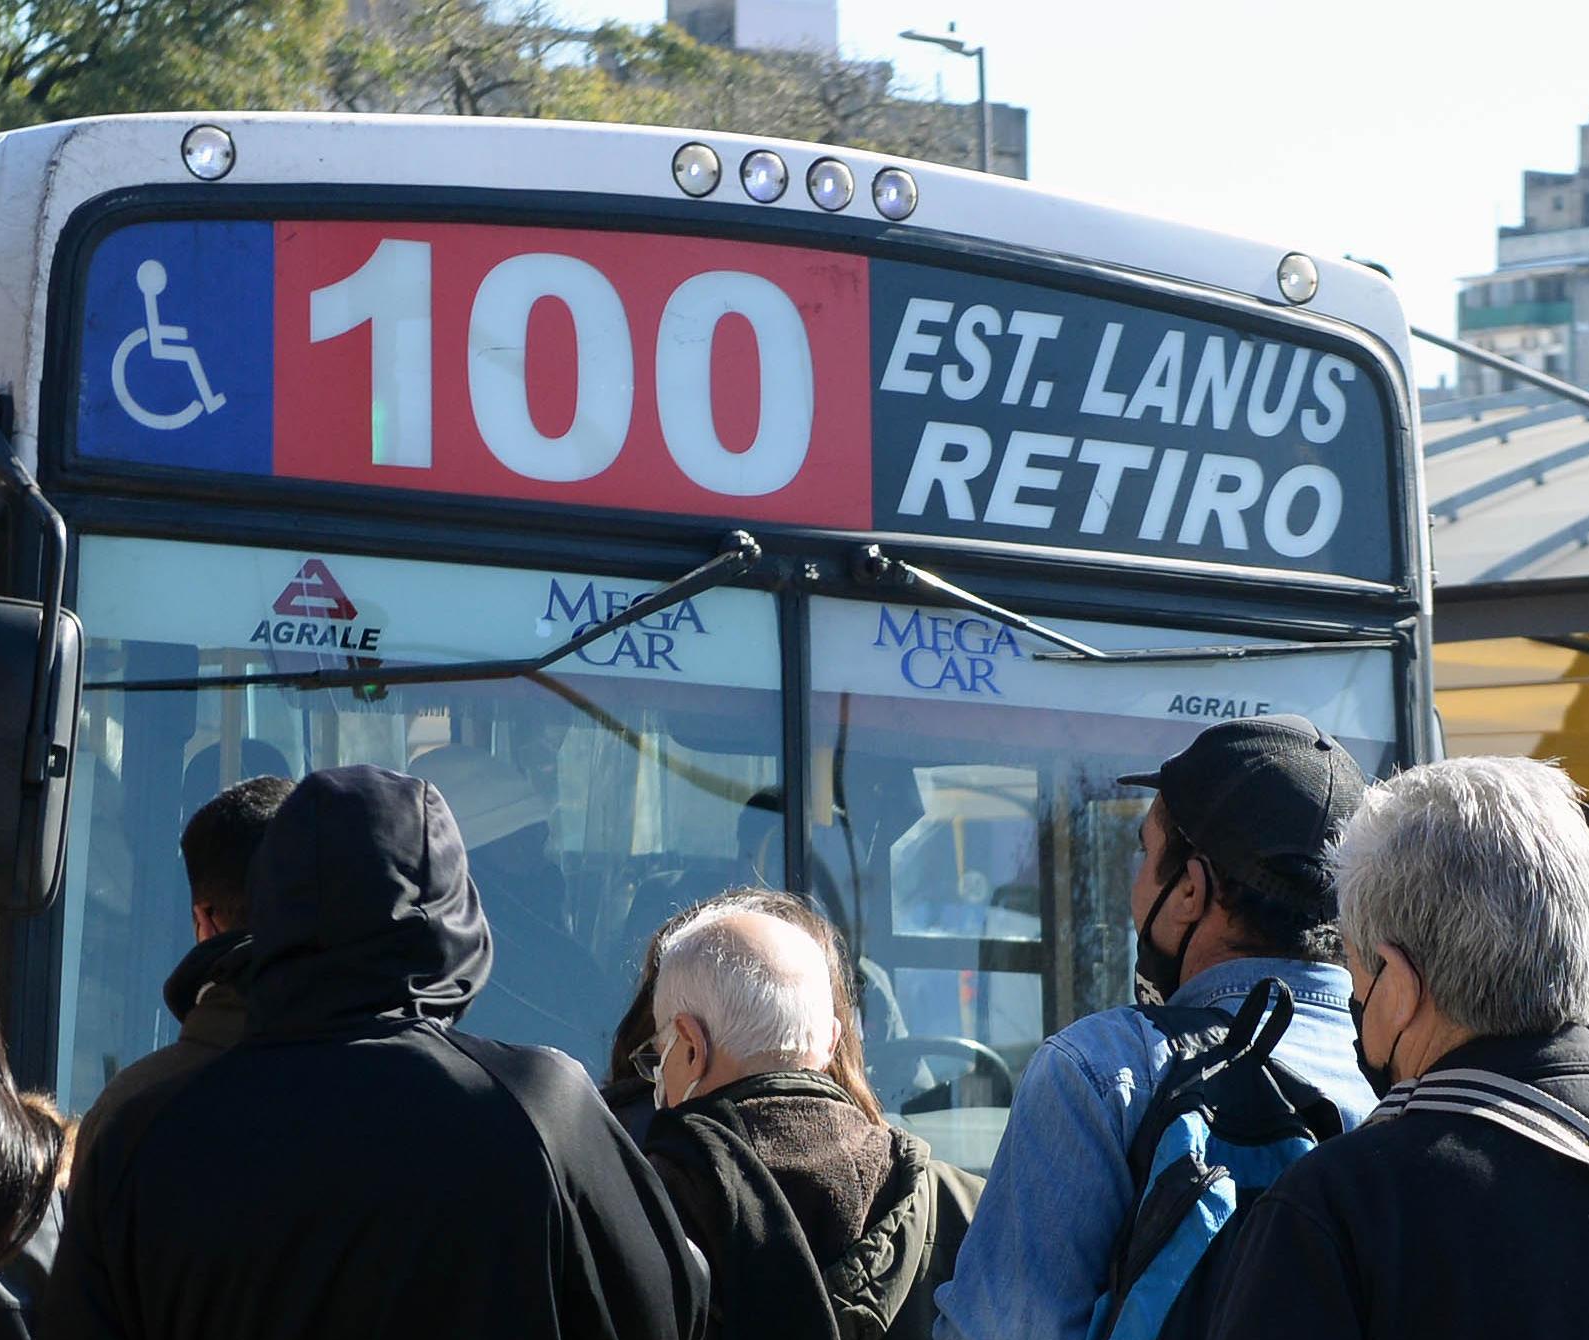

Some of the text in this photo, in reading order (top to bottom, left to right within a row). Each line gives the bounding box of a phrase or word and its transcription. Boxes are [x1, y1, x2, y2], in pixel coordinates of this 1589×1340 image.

[309, 237, 815, 497] 100
[878, 296, 1357, 445] EST. LANUS
[896, 420, 1344, 559] RETIRO
[249, 619, 381, 651] AGRALE
[571, 620, 683, 672] CAR
[872, 604, 1023, 657] MEGA
[900, 645, 1002, 694] CAR
[1168, 694, 1271, 718] AGRALE
